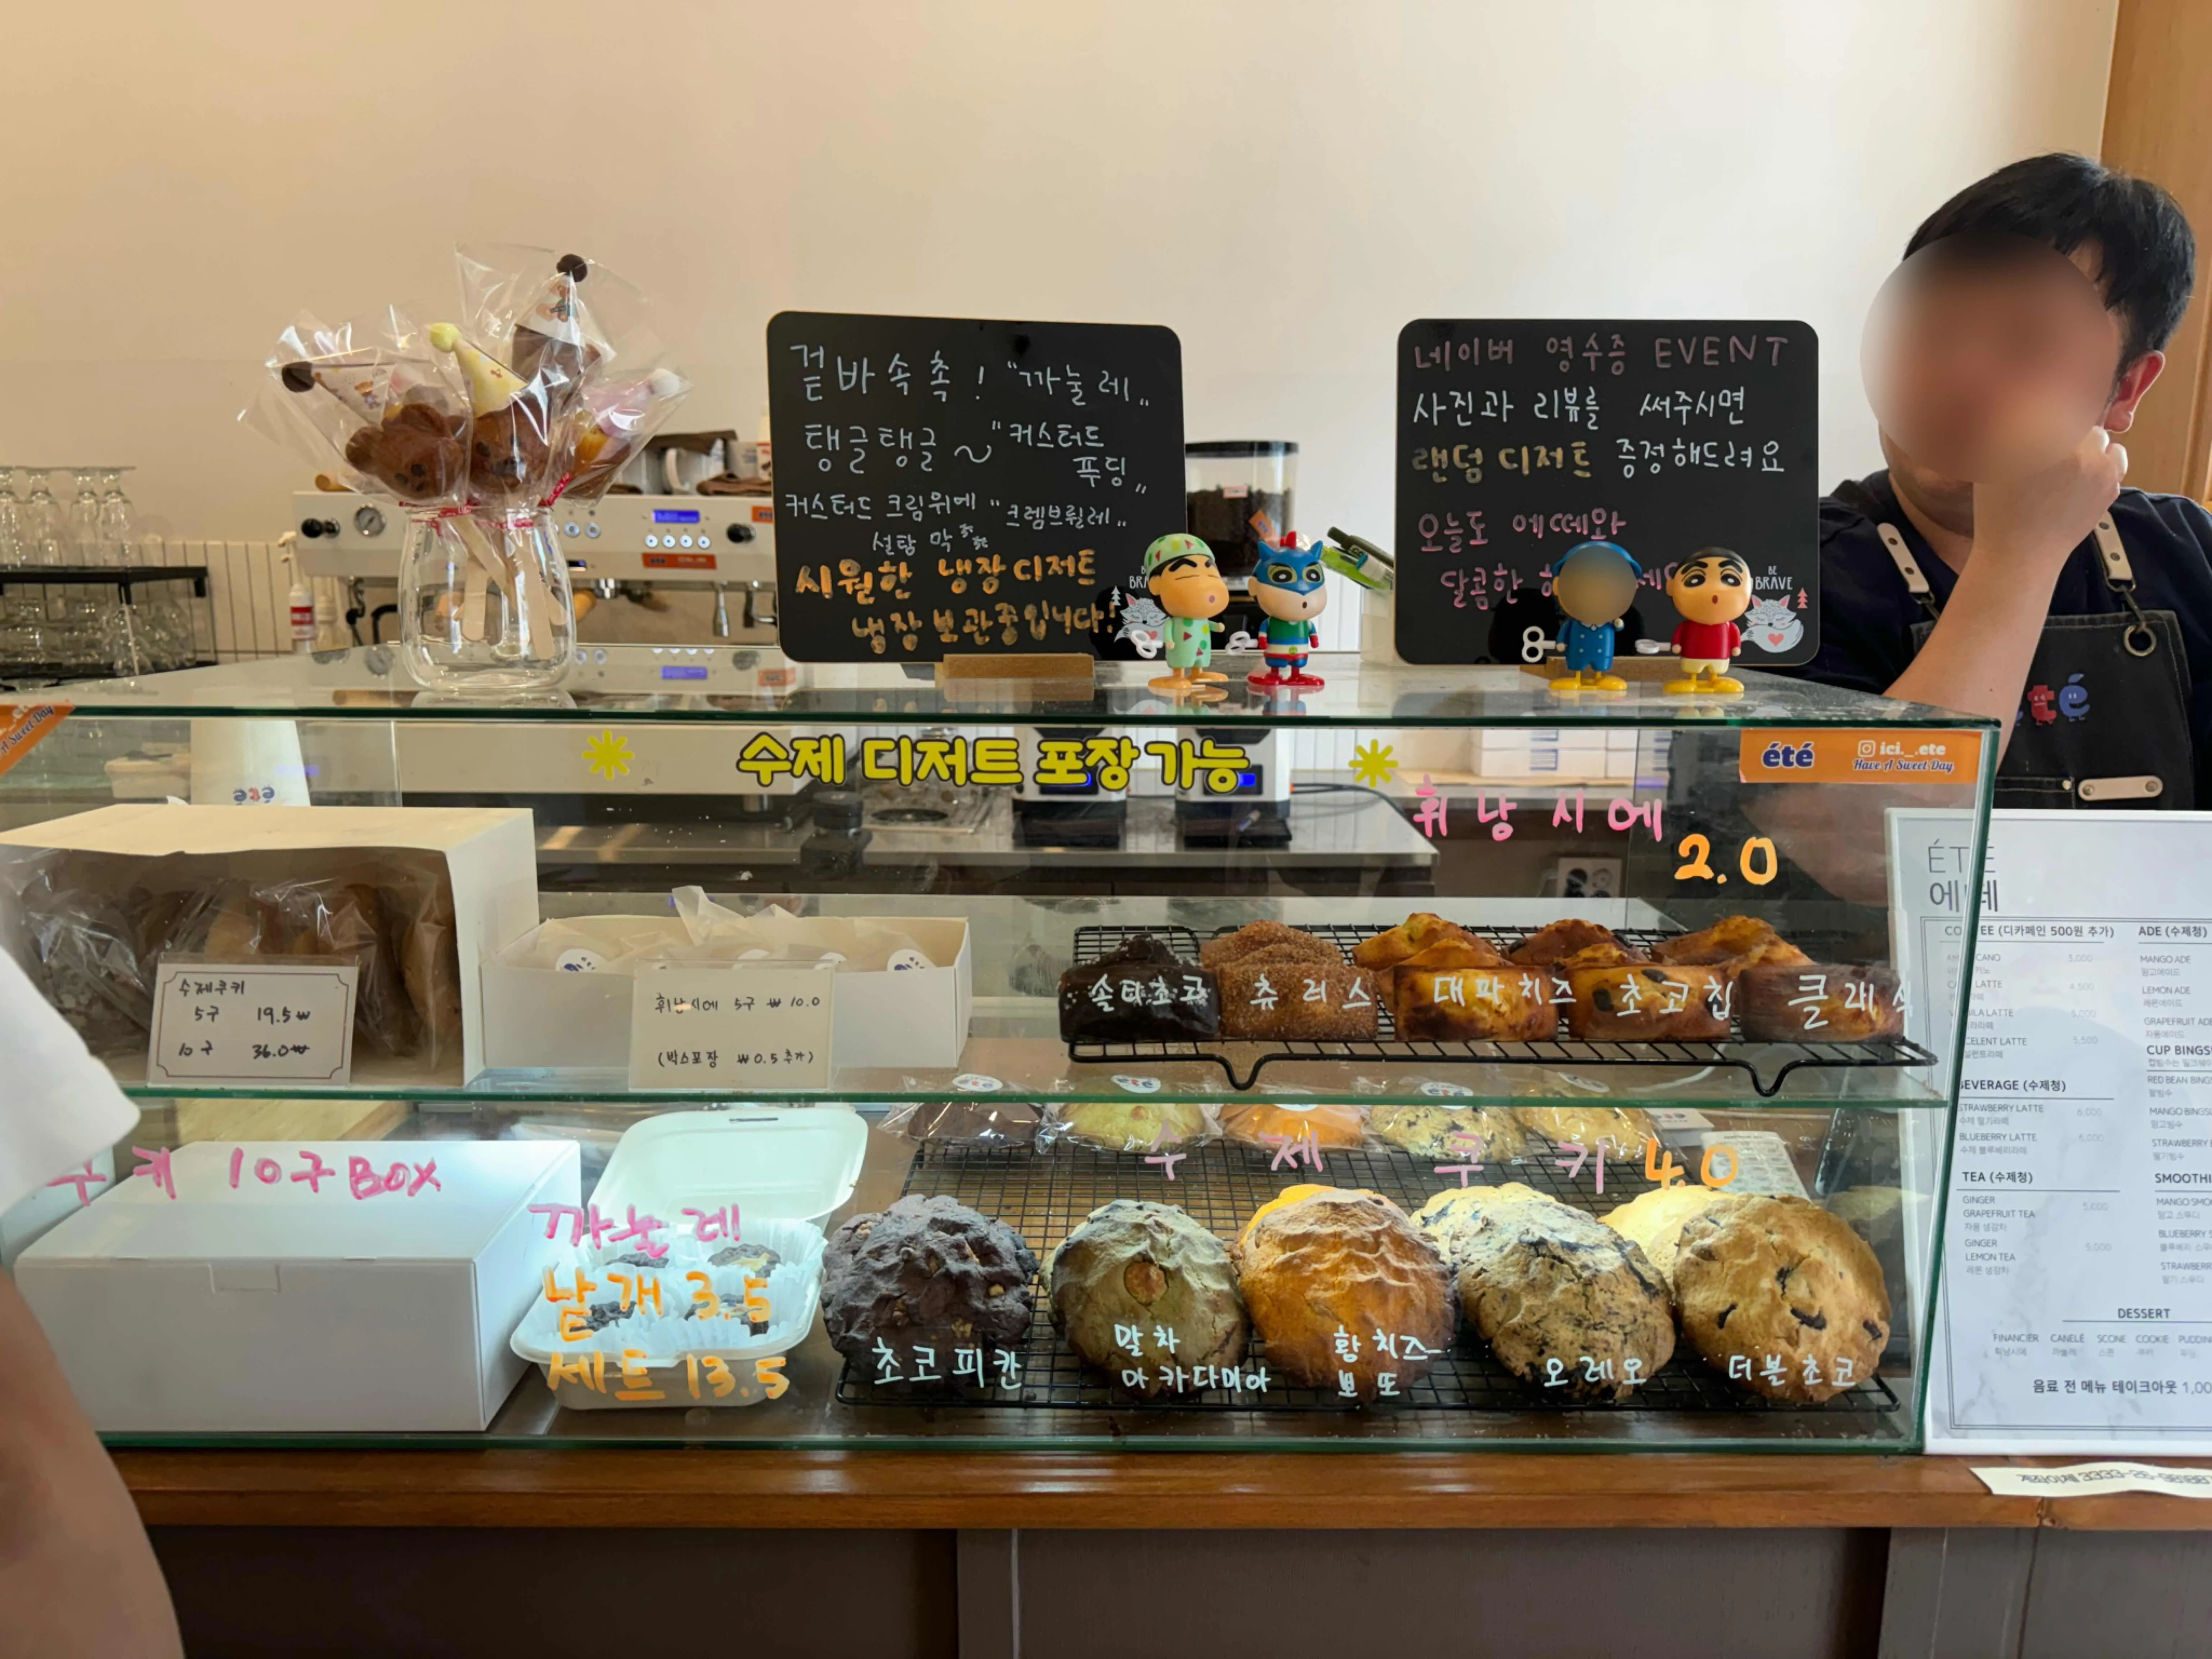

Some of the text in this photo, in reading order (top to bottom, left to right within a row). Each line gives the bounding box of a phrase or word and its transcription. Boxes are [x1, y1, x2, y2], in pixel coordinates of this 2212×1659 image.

[1415, 332, 1788, 376] 네이버 영수증 EVENT
[1413, 386, 1744, 430] 사진과 리뷰를 써주시면
[1412, 437, 1785, 483] 랜덤 디저트 증정해드려요
[1418, 510, 1489, 553] 오늘도
[795, 549, 1096, 605] 시원한 냉장 디저트
[1141, 565, 1146, 574] B
[1768, 565, 1777, 575] BE
[1441, 561, 1524, 611] 달콤한
[1754, 576, 1793, 591] BRAVE
[852, 611, 922, 654] 냉장
[1762, 741, 1815, 769] été
[735, 731, 1252, 795] 수제 디저트 포장 가능
[1853, 759, 1955, 773] Have A Sweet Day
[1674, 832, 1779, 885] 2.0
[1945, 925, 1994, 936] COEE
[2138, 926, 2162, 936] ADE
[179, 978, 245, 997] 수제쿠키
[1617, 973, 1731, 1021] 초코칩
[194, 1006, 220, 1022] 5구
[2144, 1017, 2195, 1026] GRAPEFRUIT
[2146, 1045, 2212, 1055] CUP BINGS
[2147, 1076, 2212, 1084] RED BEAN BINGS
[2017, 1104, 2044, 1112] LATTE
[1959, 1133, 2037, 1142] BLUEBERRY LATTE
[2152, 1139, 2208, 1148] STRAWBERRY
[1644, 1137, 1740, 1190] 4.0
[1962, 1172, 1985, 1182] TEA
[2155, 1173, 2212, 1183] SMOOTHI
[1962, 1196, 1996, 1204] GINGER
[2157, 1198, 2190, 1206] MANGO
[1963, 1209, 2036, 1218] GRAPEFRUIT TEA
[2158, 1230, 2206, 1238] BLUEBERRY
[1964, 1239, 1997, 1247] GINGER
[1965, 1253, 2016, 1261] LEMON TEA
[543, 1265, 772, 1343] 낱개 3.5
[2118, 1308, 2171, 1318] DESSERT
[1114, 1324, 1181, 1357] 말차
[1993, 1334, 2038, 1343] FINANCIER
[2097, 1335, 2126, 1343] SCONE
[2136, 1335, 2169, 1343] COOKIE
[2178, 1335, 2212, 1344] PUDDIN
[872, 1337, 1022, 1390] 초코피칸
[1543, 1354, 1648, 1388] 오레오
[1728, 1354, 1857, 1388] 더블초코
[546, 1349, 790, 1401] 세트 13.5
[2033, 1379, 2212, 1395] 음료 전 메뉴 테이크아웃 1,00
